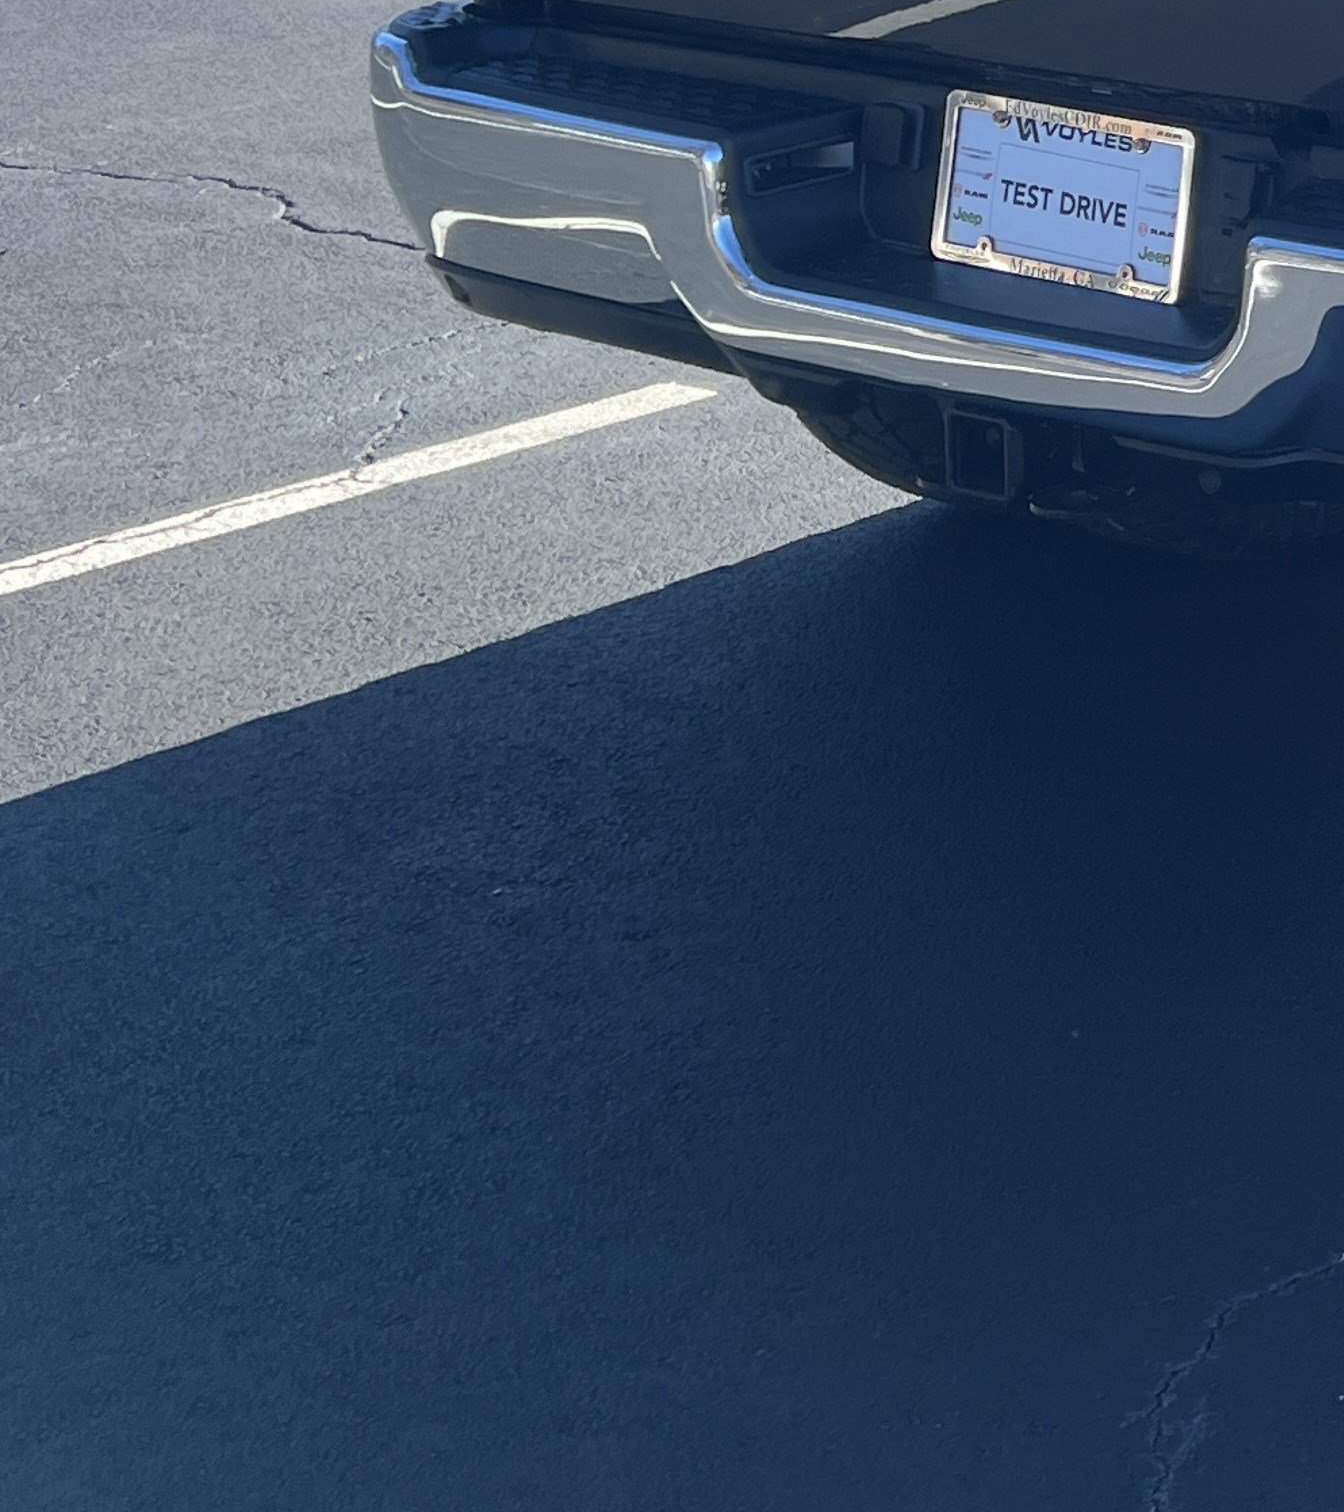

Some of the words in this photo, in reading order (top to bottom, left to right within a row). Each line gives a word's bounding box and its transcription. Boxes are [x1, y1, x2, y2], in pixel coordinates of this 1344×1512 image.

[1042, 120, 1133, 153] VOYLES
[953, 206, 983, 227] Jeep
[1001, 178, 1053, 211] TEST
[1059, 191, 1128, 228] DRIVE
[1138, 245, 1172, 267] Jeep
